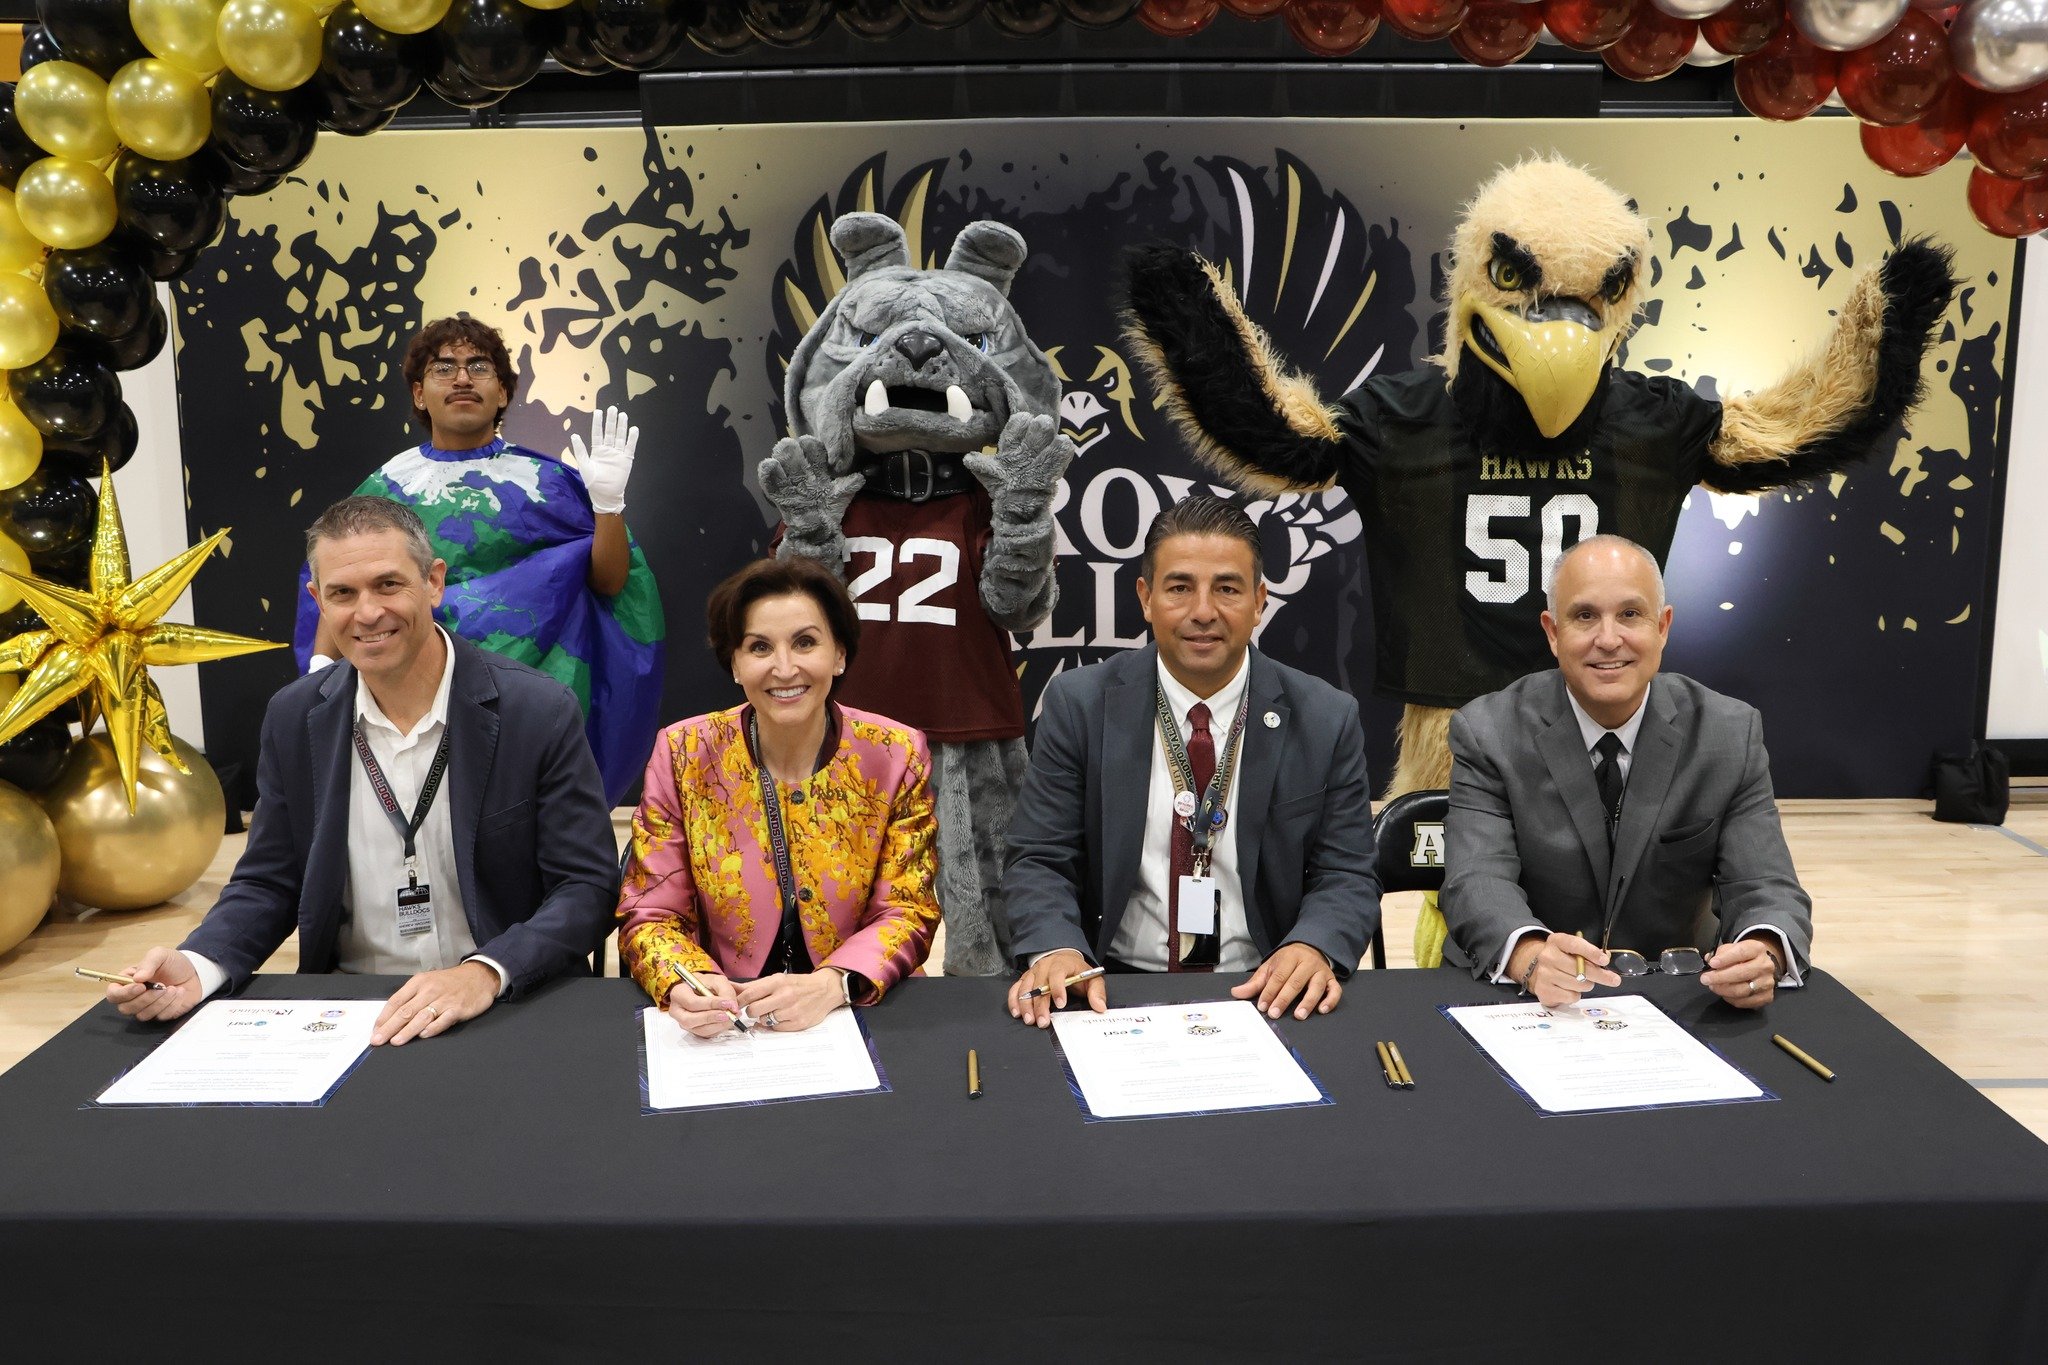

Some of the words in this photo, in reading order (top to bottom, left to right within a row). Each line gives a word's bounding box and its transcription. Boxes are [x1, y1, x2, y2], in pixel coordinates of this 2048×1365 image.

[1465, 494, 1599, 604] 50
[842, 536, 960, 627] 22
[1159, 710, 1181, 751] VALLEY
[365, 756, 398, 813] BULLDOGS
[420, 764, 443, 806] ARROYO
[1173, 768, 1185, 792] ALLEY
[761, 775, 781, 839] REDLANDS
[1103, 1030, 1128, 1038] esri
